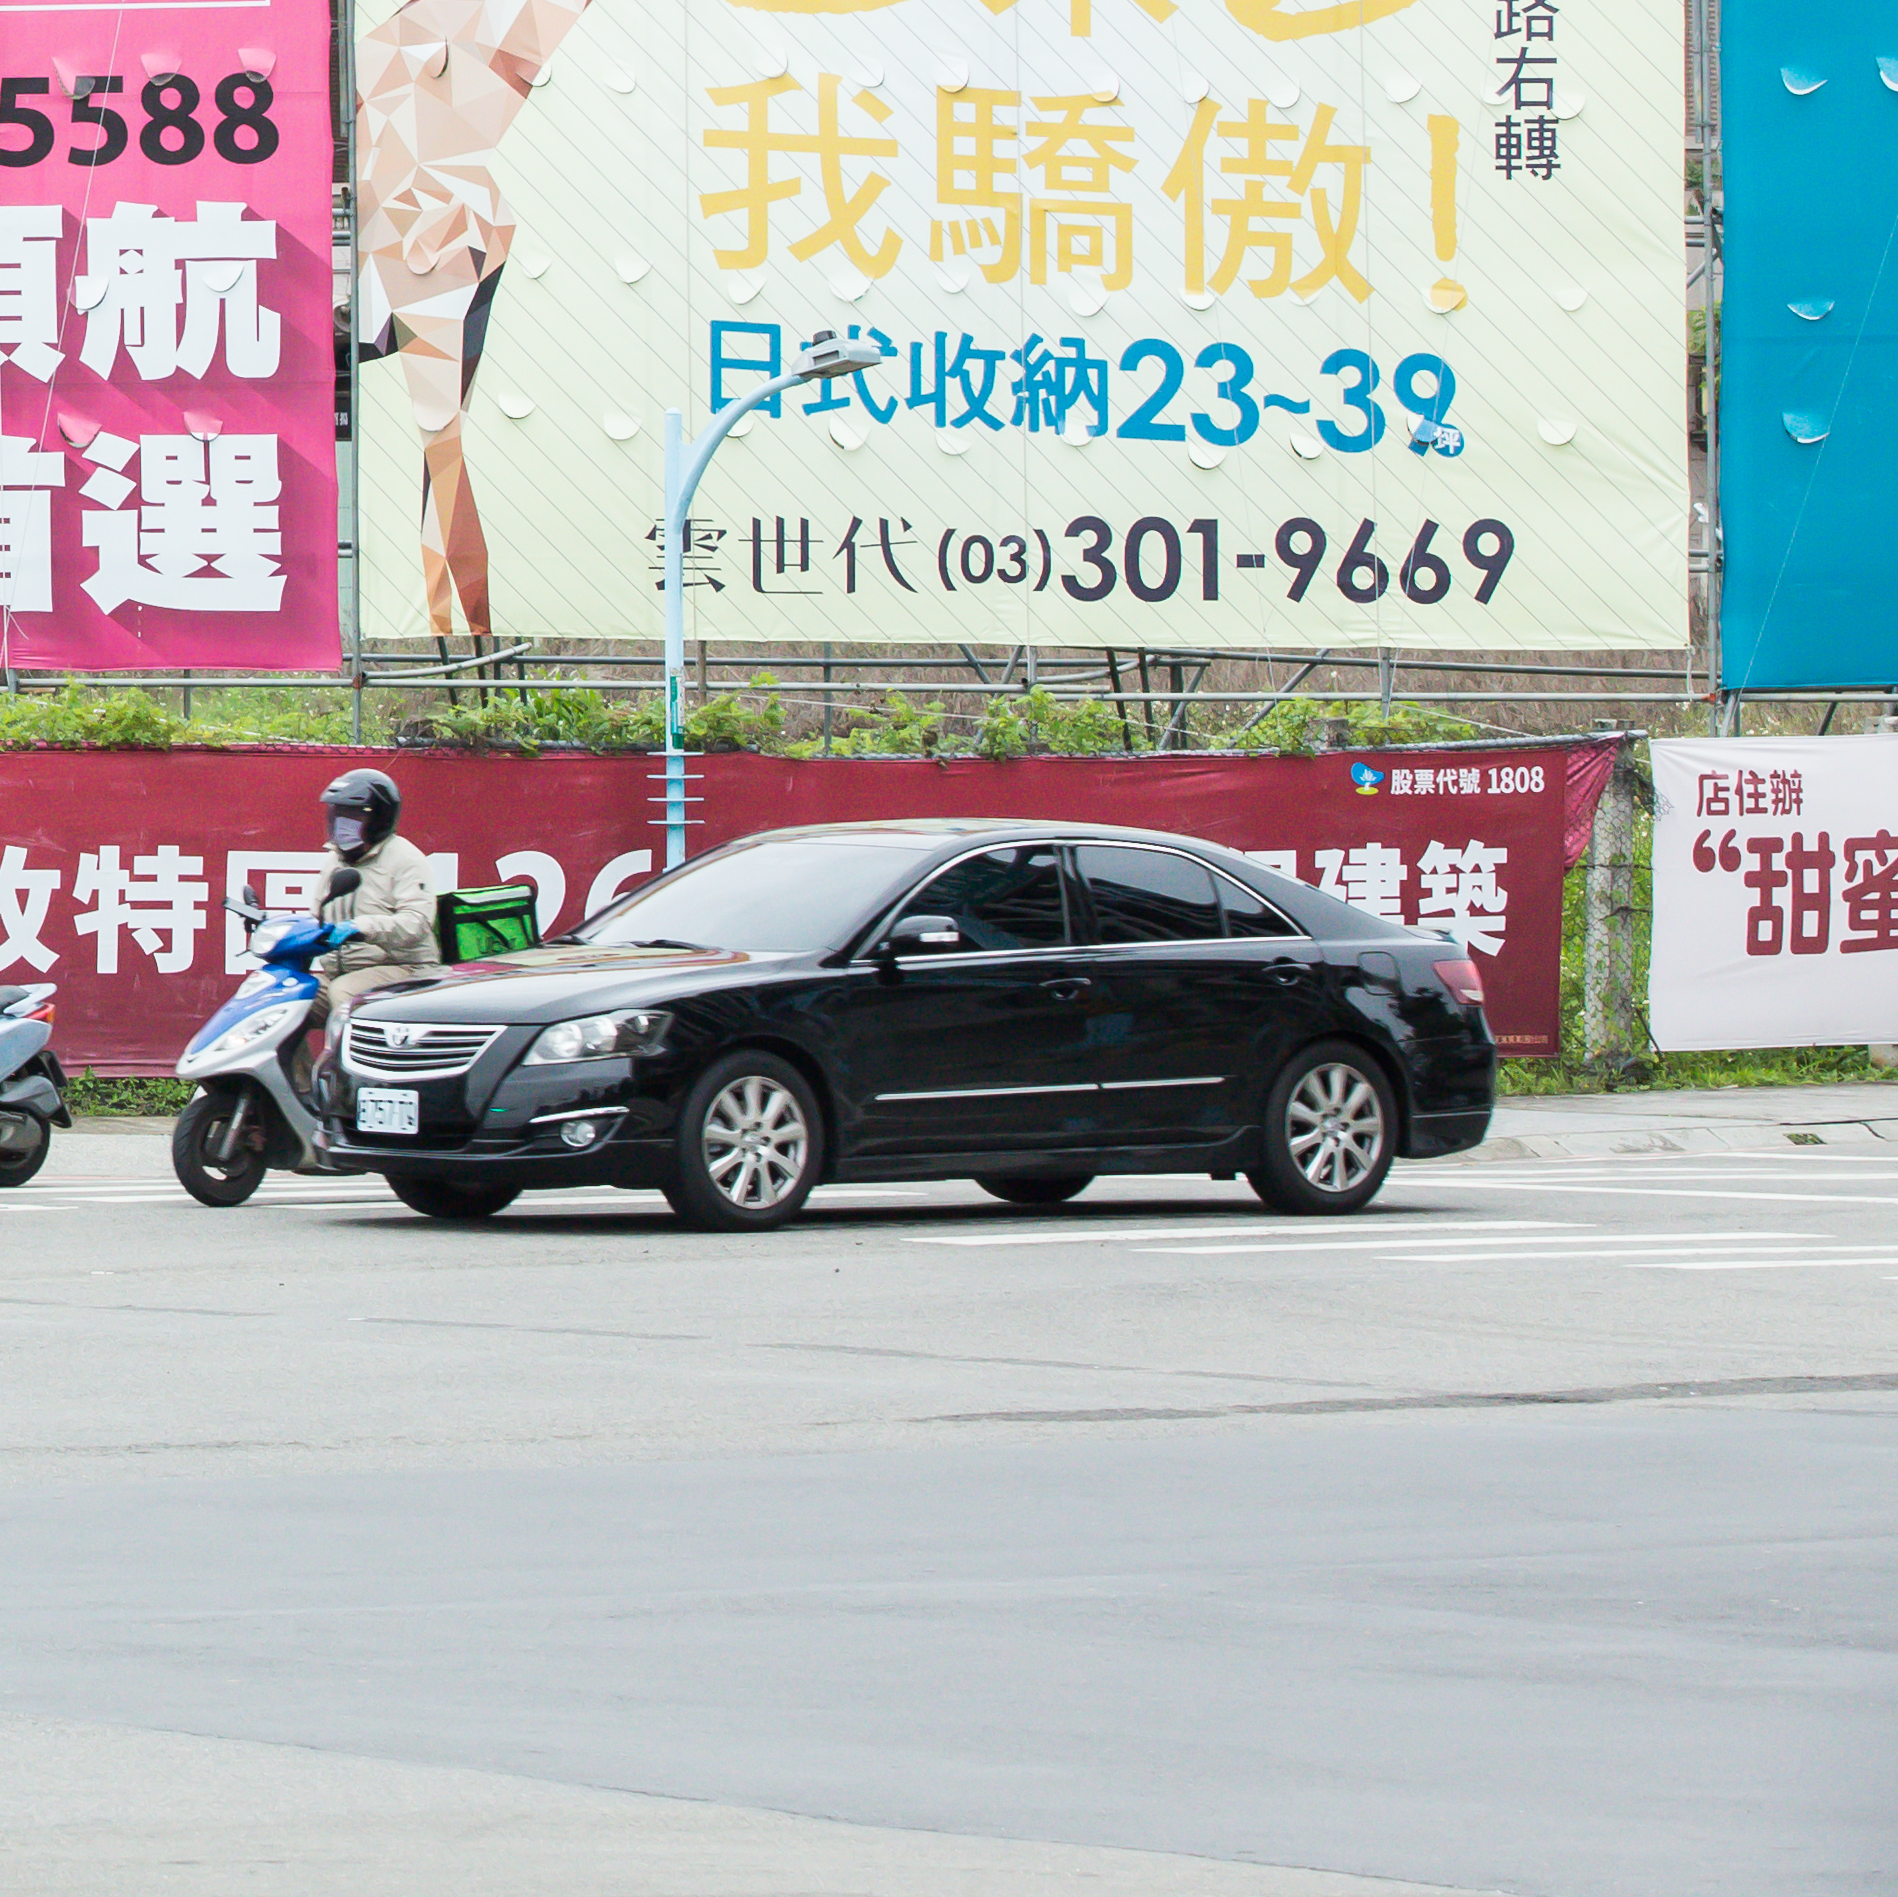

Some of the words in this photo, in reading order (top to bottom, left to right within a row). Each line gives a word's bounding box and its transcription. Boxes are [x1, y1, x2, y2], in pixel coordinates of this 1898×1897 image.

[937, 527, 1053, 592] (03)
[1061, 514, 1516, 606] 301-9669
[1389, 767, 1482, 796] 股票代號
[1486, 765, 1546, 795] 1808
[1697, 769, 1804, 817] 店住辦
